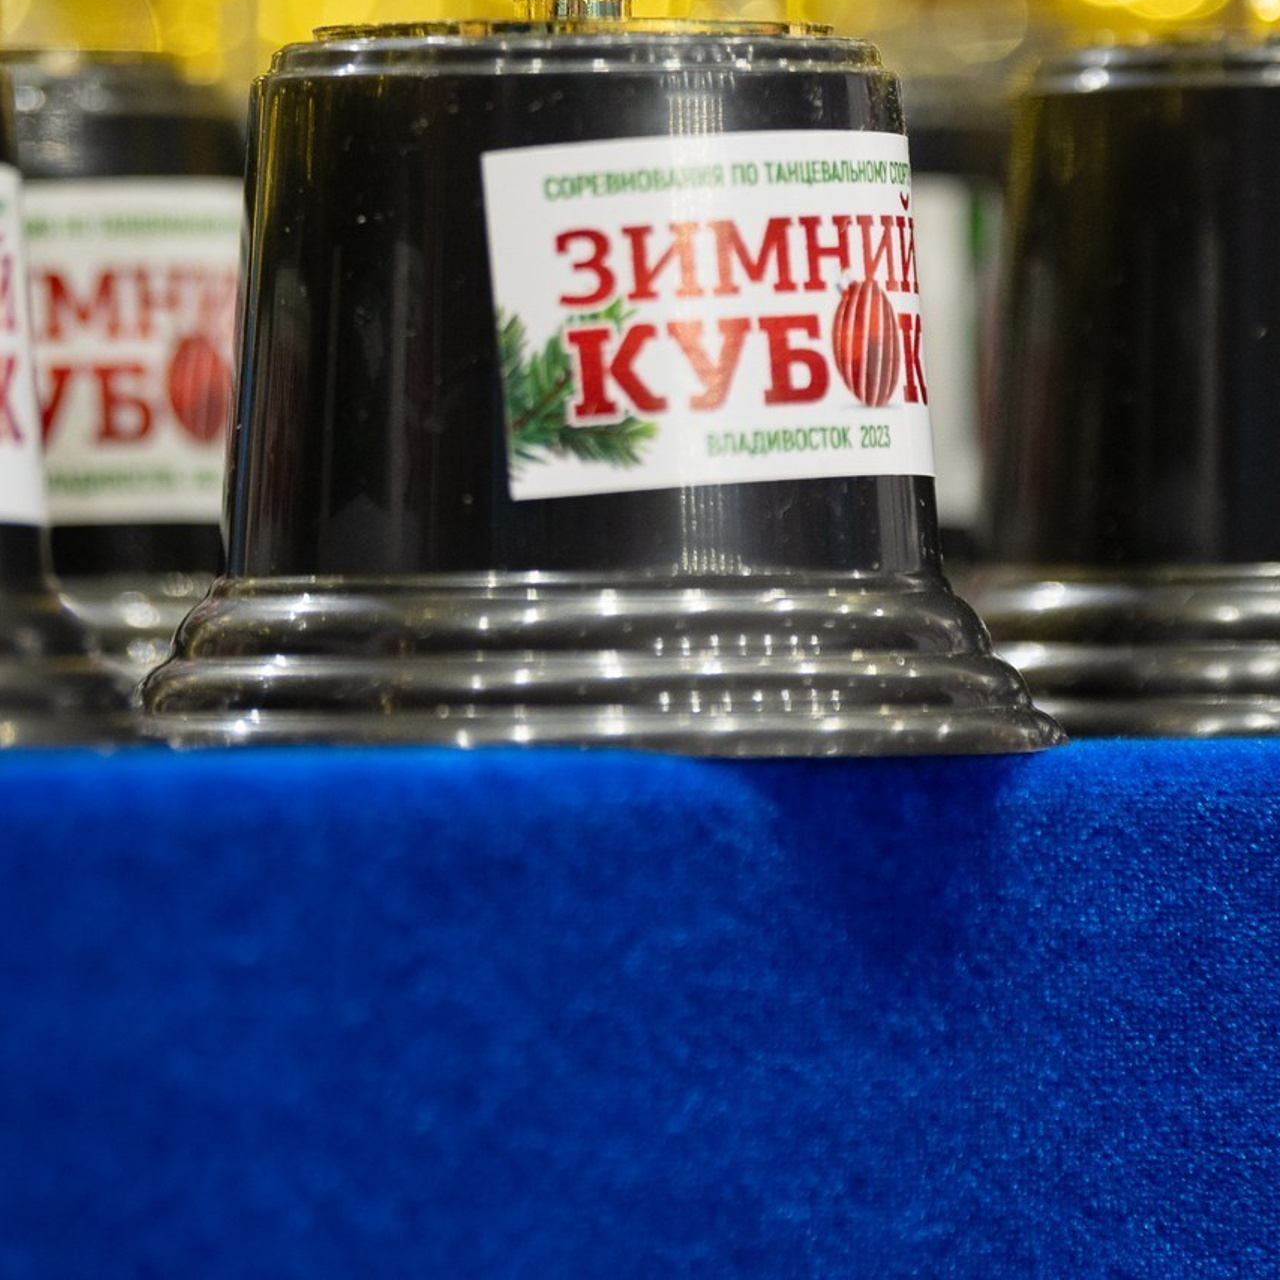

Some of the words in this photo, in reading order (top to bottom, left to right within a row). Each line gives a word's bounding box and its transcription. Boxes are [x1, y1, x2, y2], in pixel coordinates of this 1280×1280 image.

[731, 161, 758, 185] ПО
[764, 159, 887, 186] ТАНЦЕВАЛЬНОМУ
[554, 192, 920, 308] ЗИМНИЙ
[568, 284, 929, 421] КУБОК
[707, 426, 852, 457] ВЛАДИВОСТОК
[860, 424, 891, 448] 2023
